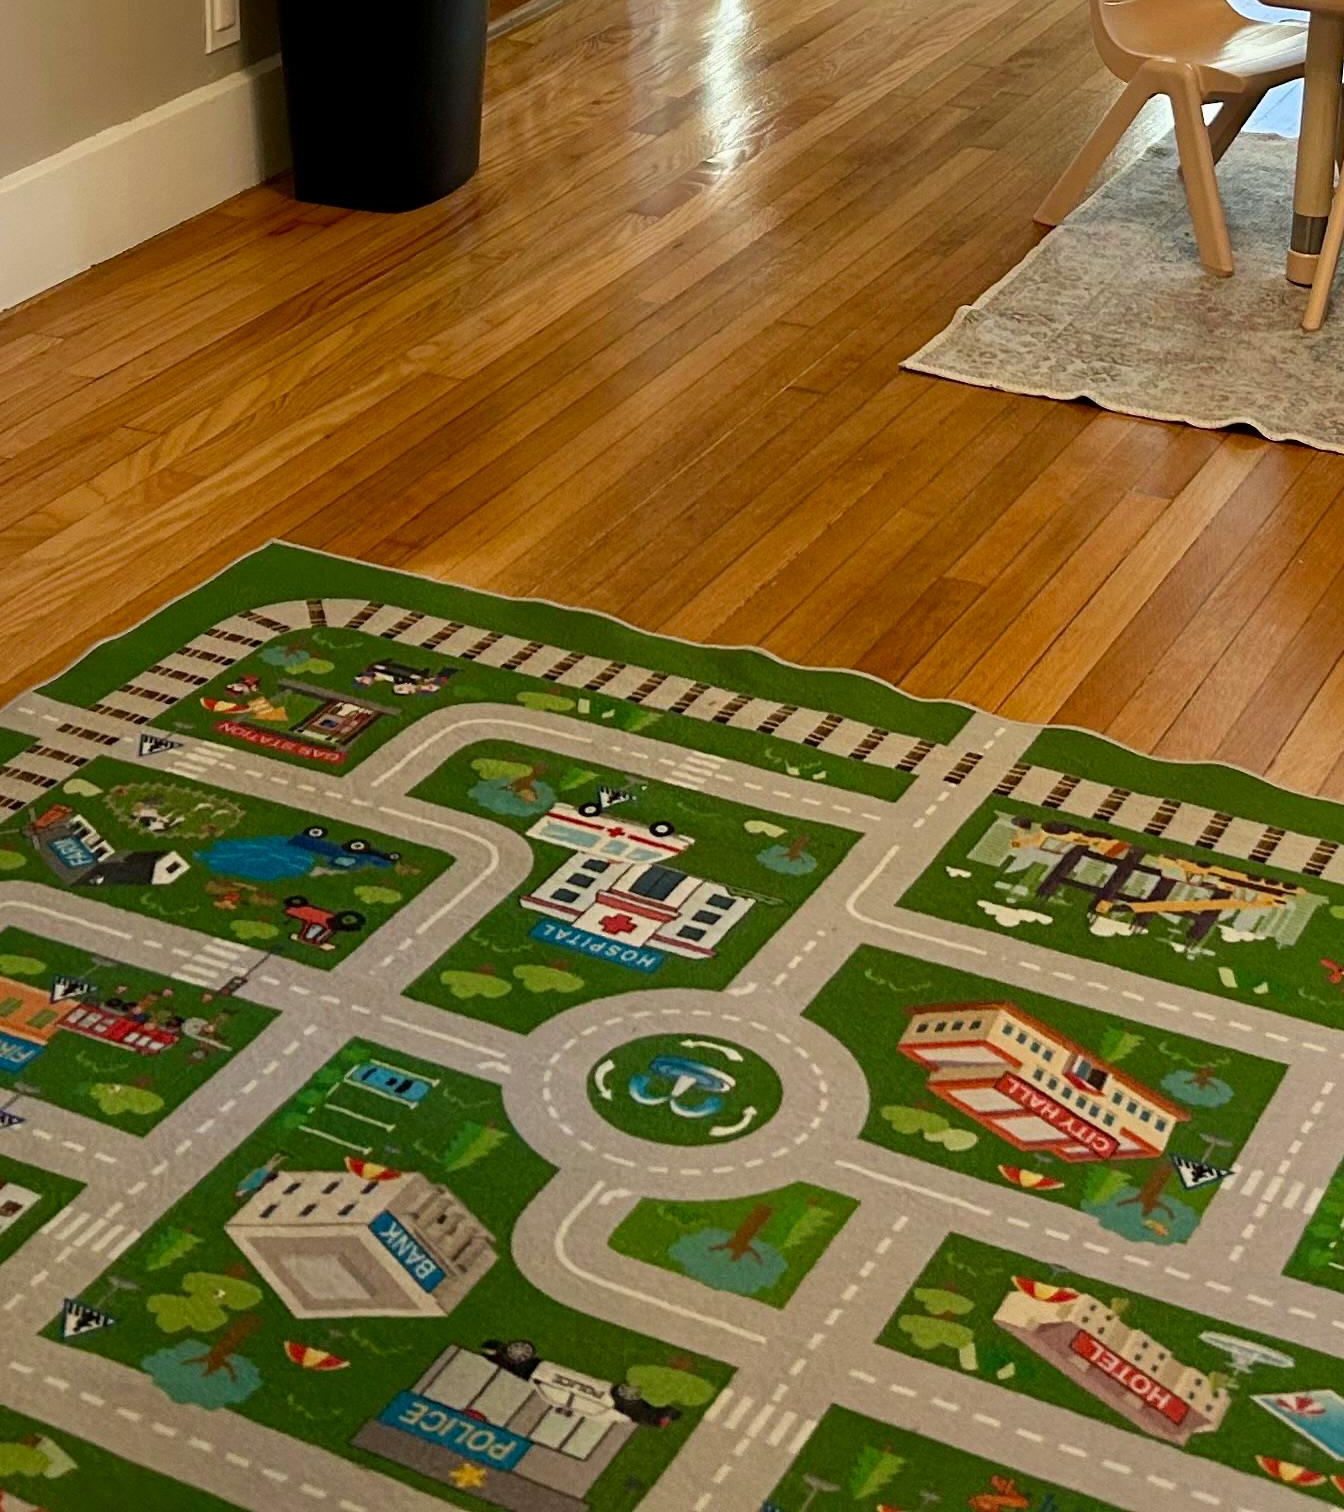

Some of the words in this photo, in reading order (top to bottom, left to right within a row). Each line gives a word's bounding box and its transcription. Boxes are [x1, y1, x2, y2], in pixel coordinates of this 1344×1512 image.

[219, 722, 294, 750] STATION
[304, 746, 340, 762] GAS
[53, 838, 93, 866] FARM
[544, 924, 656, 967] HOSPITAL
[1008, 1077, 1060, 1119] HALL
[1059, 1117, 1110, 1151] CITY
[378, 1221, 436, 1279] BANK
[552, 1373, 605, 1399] POLICE
[1090, 1340, 1172, 1409] HOTEL
[399, 1402, 517, 1460] POLICE
